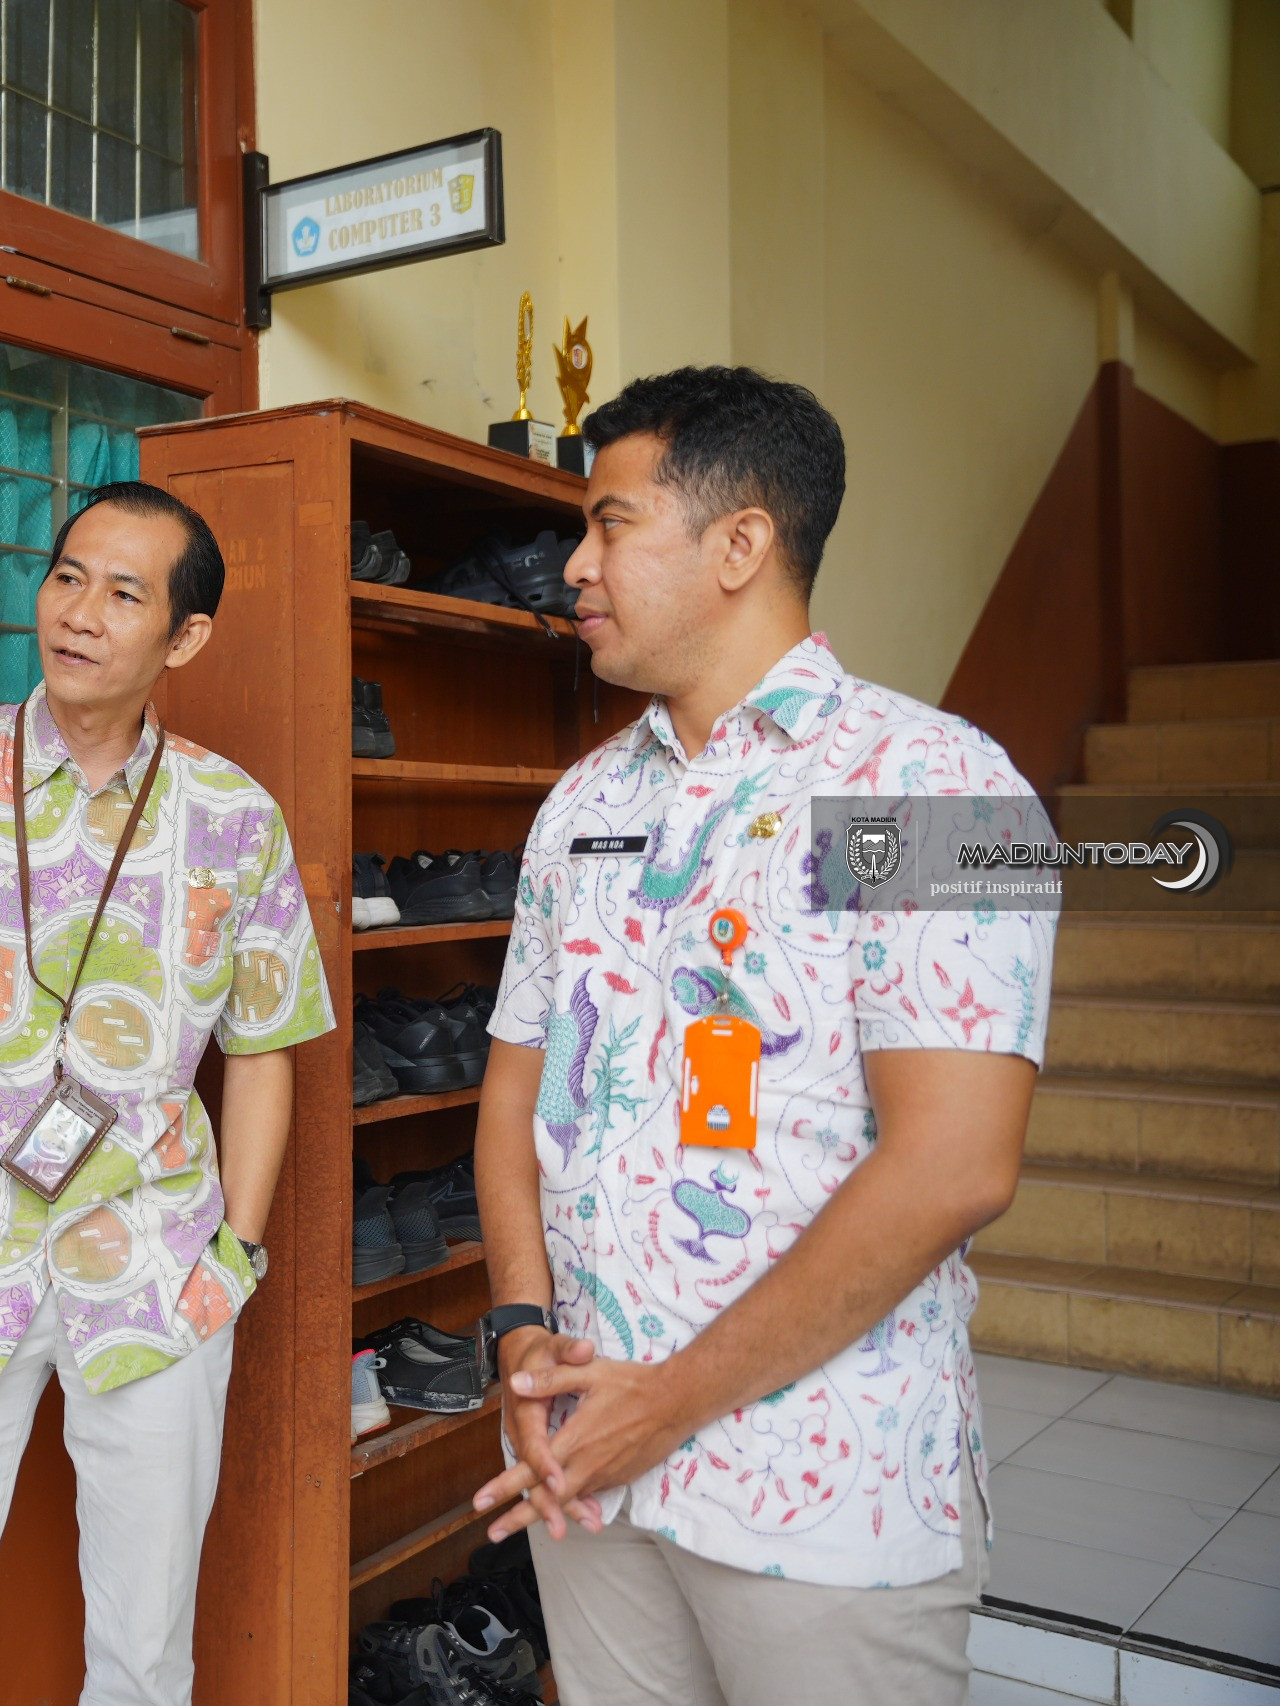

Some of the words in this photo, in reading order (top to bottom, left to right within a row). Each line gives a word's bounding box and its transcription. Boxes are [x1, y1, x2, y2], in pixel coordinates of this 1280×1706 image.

[325, 167, 444, 218] LABORATORIUM
[328, 208, 423, 252] COMPUTER
[430, 203, 442, 228] 3
[226, 564, 266, 590] DIUN
[591, 840, 608, 850] MAS
